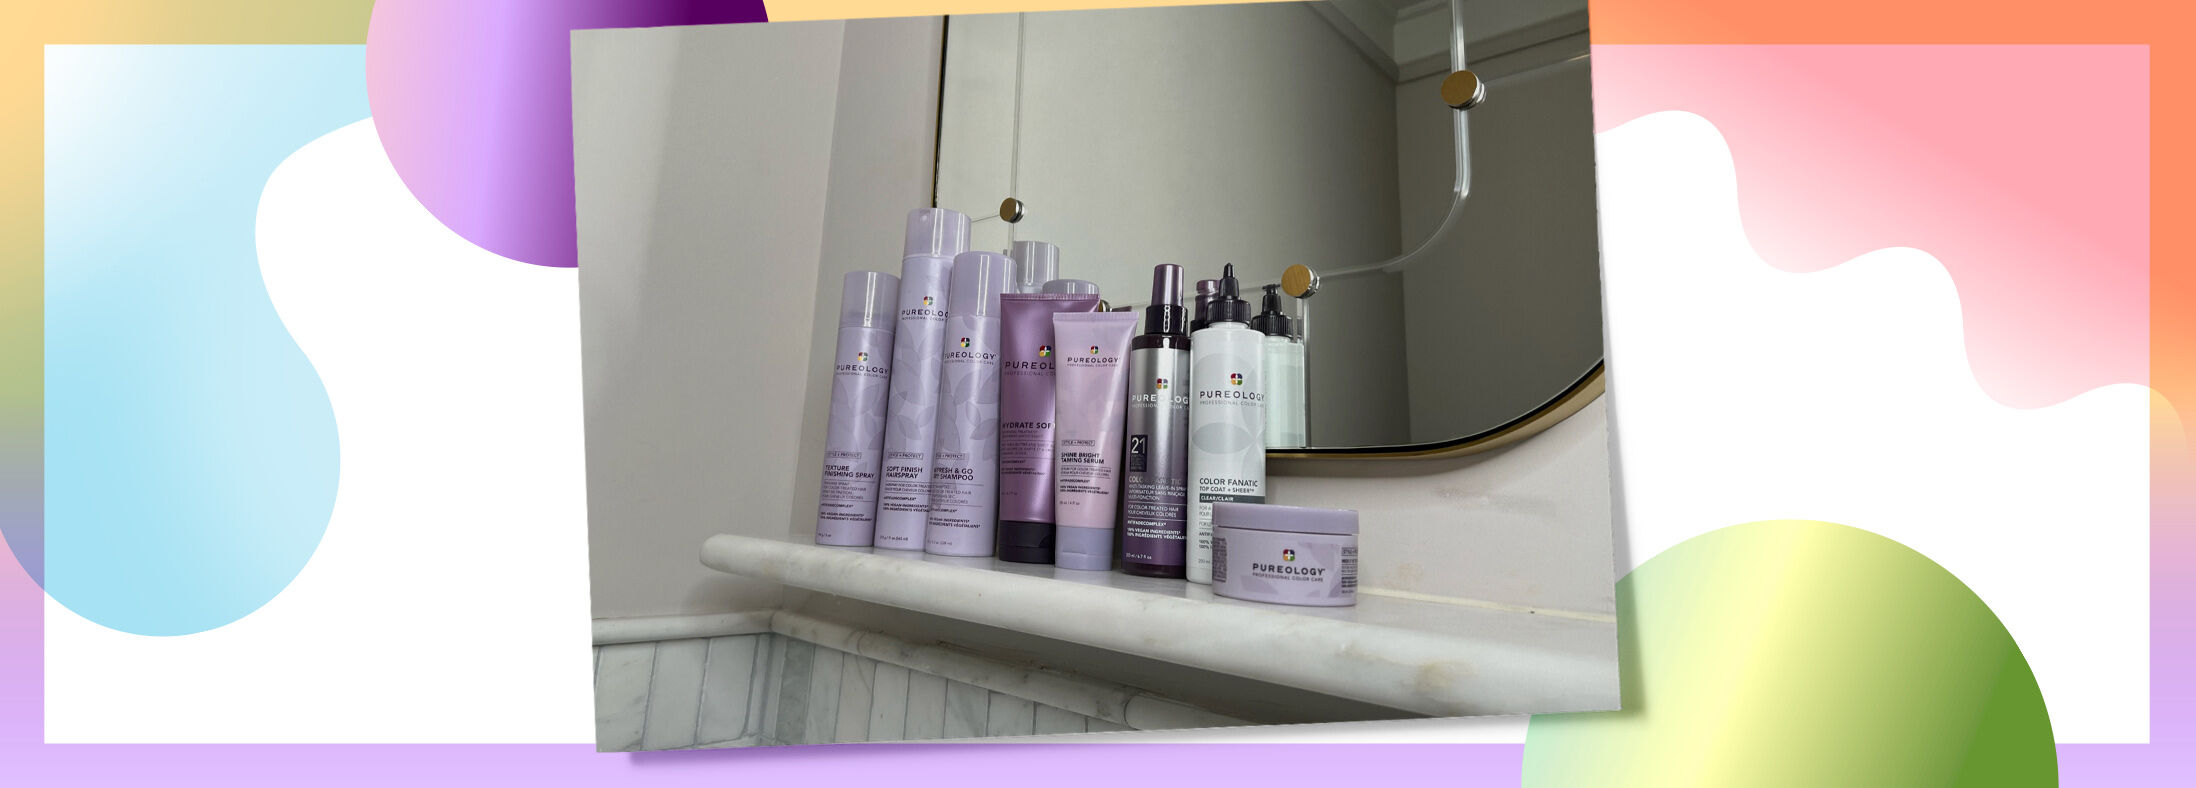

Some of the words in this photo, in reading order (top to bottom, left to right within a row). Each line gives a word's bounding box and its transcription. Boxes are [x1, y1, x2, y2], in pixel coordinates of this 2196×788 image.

[836, 364, 889, 374] PUREOLOGY
[1200, 390, 1264, 401] PUREOLOGY
[1002, 422, 1034, 430] HYDRATE
[1131, 437, 1146, 454] 21
[825, 464, 850, 472] TEXTURE
[824, 470, 854, 478] FINISHING
[940, 473, 974, 481] SHAMPOO
[1200, 477, 1225, 485] COLOR
[1227, 479, 1258, 487] FANATIC
[1252, 563, 1325, 575] PUREOLOGY
